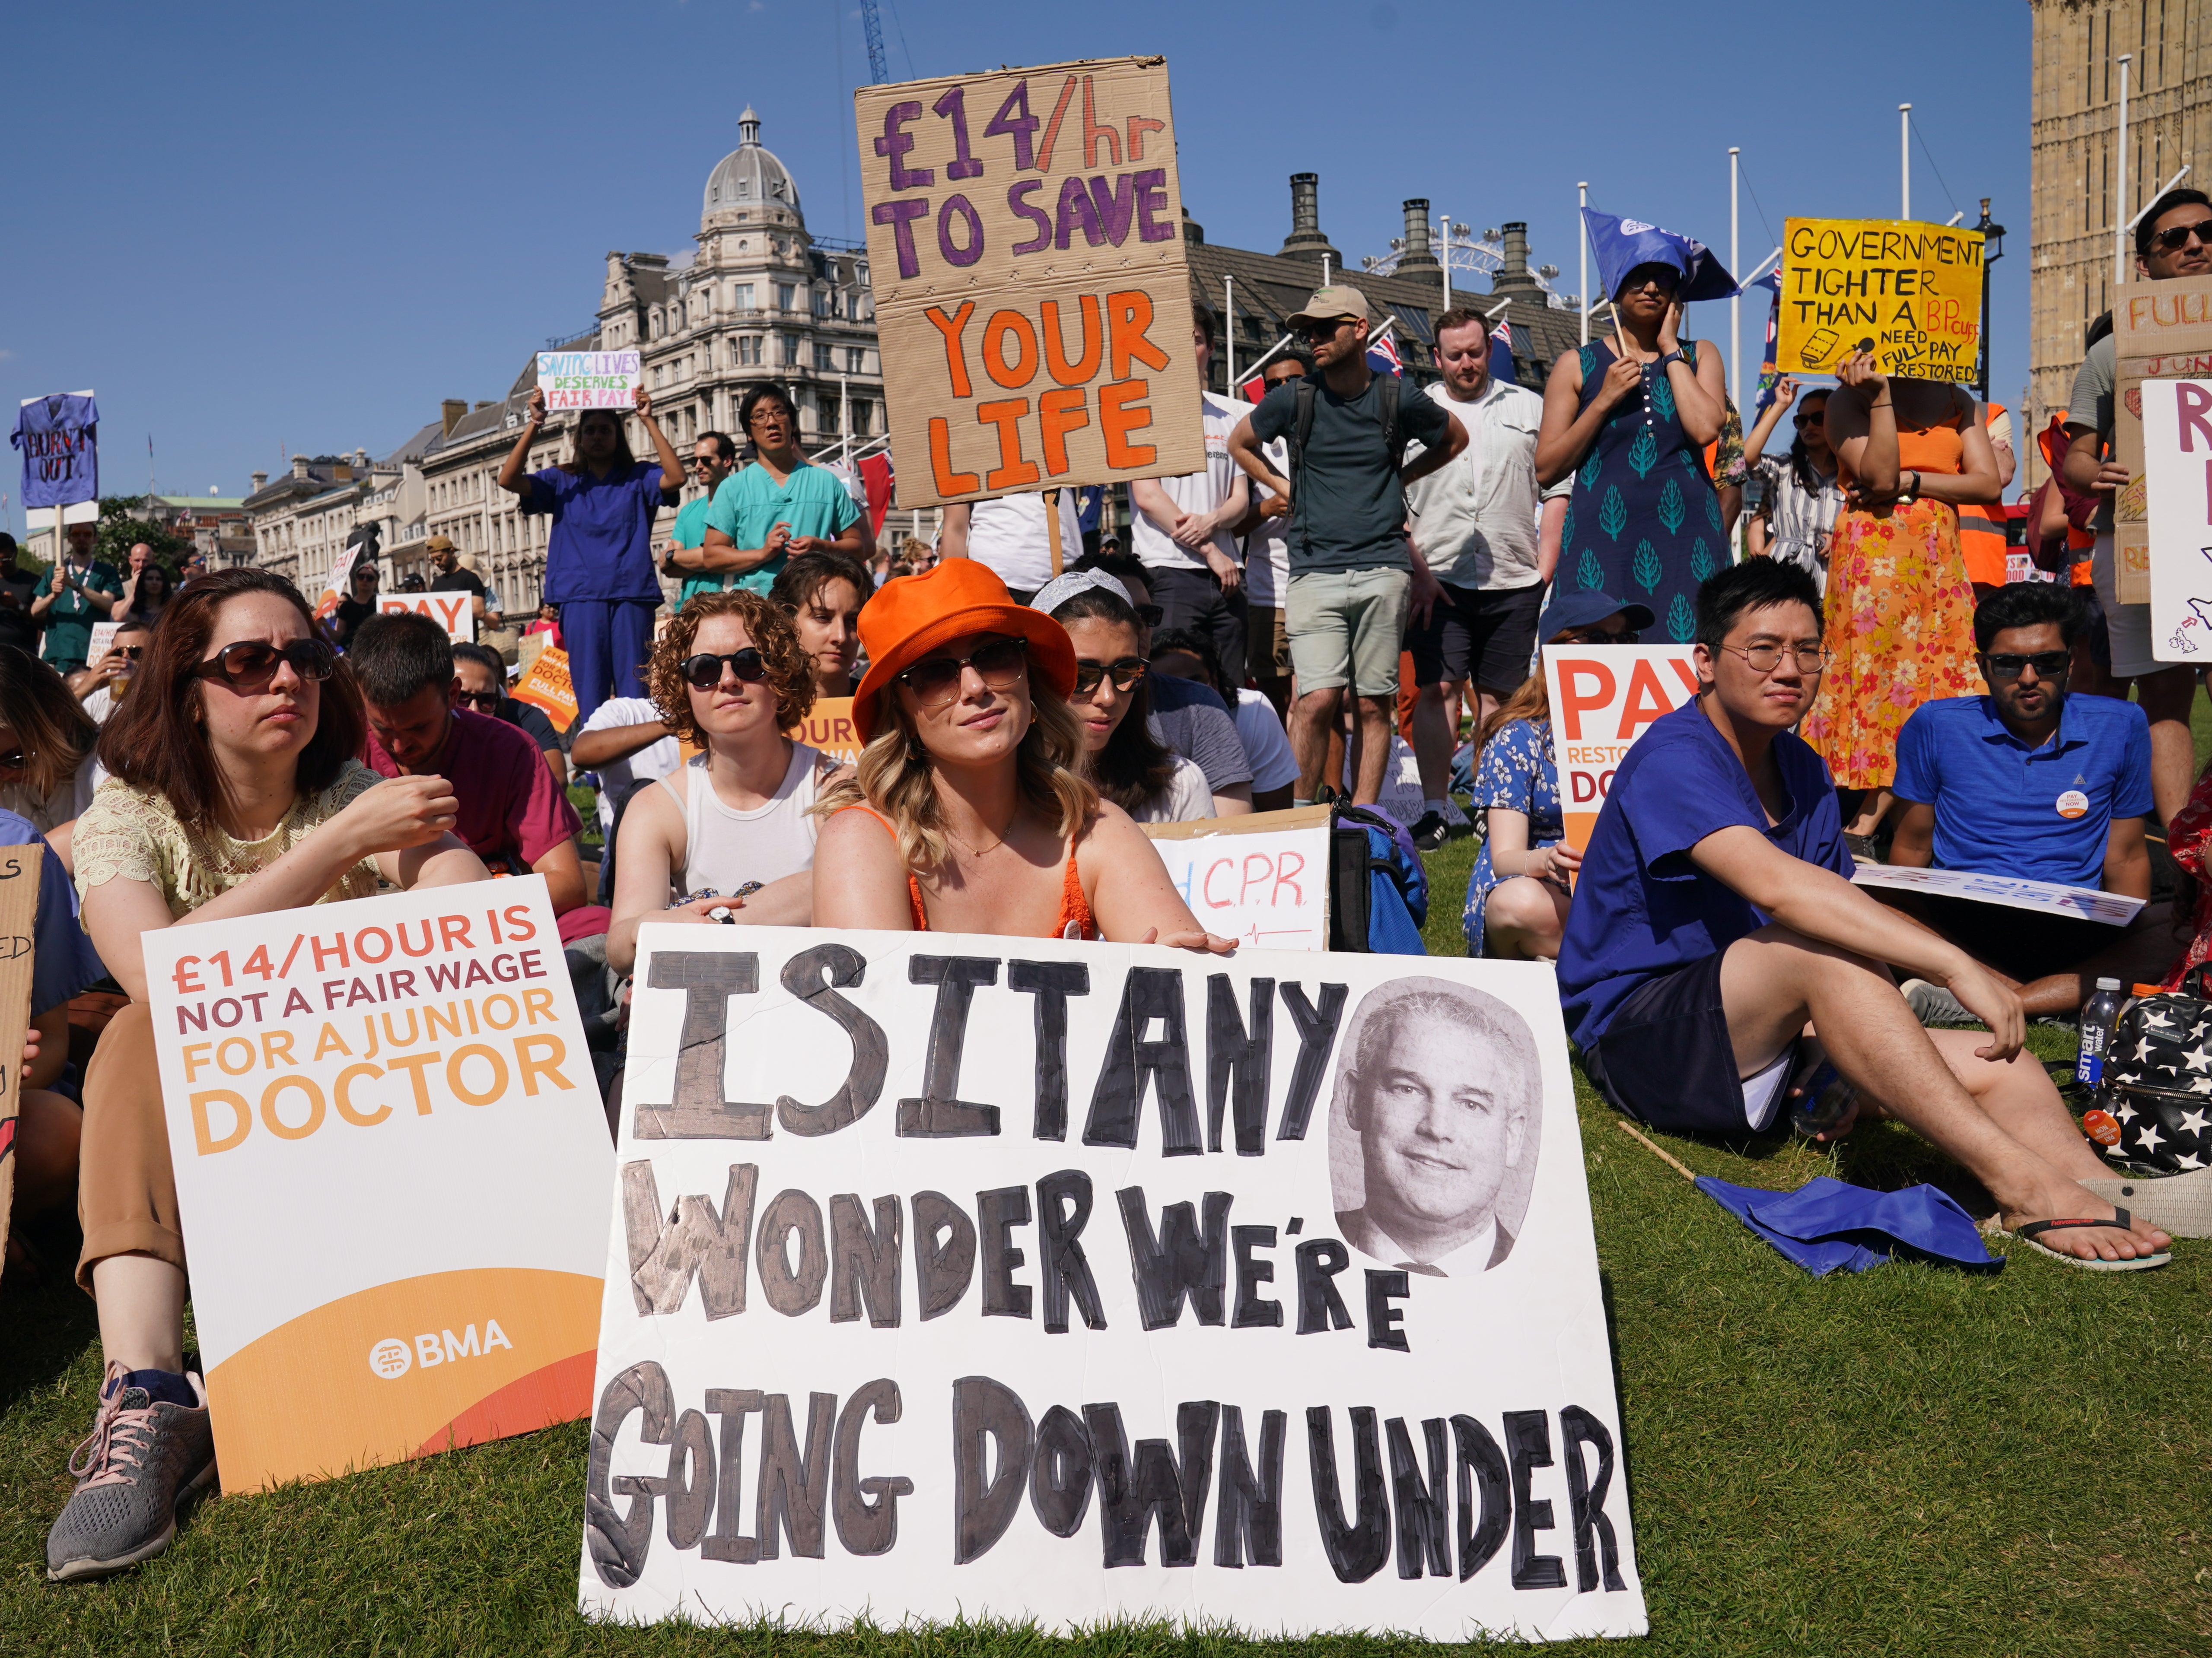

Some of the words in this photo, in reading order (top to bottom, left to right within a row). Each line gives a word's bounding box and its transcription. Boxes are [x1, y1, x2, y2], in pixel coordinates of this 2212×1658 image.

[874, 75, 1165, 191] £14/hr
[872, 194, 984, 279] TO
[1008, 168, 1175, 257] SAVE
[1791, 227, 1985, 267] GOVERNMENT
[1792, 268, 1939, 297] TIGHTER
[1792, 301, 1877, 326] THAN
[1892, 301, 1916, 330] A
[1927, 299, 1960, 332] BP
[923, 289, 1171, 398] YOUR
[1881, 330, 1927, 344] NEED
[1882, 343, 1926, 367] FULL
[1929, 341, 1962, 361] PAY
[595, 353, 638, 374] LIVES
[549, 390, 592, 409] FAIR
[555, 375, 628, 389] DESERVES
[928, 378, 1157, 498] LIFE
[331, 546, 359, 575] PAY
[538, 659, 555, 670] FOR
[542, 654, 557, 664] NOT
[530, 677, 555, 694] FULL
[557, 689, 576, 703] PAY
[172, 914, 476, 994] £14/HOUR
[486, 905, 537, 945] IS
[176, 992, 268, 1035] NOT
[283, 987, 314, 1018] A
[322, 970, 420, 1011] FAIR
[425, 949, 548, 993] WAGE
[181, 1030, 299, 1083] FOR
[313, 1022, 353, 1062] A
[363, 988, 560, 1060] JUNIOR
[632, 943, 889, 1141] IS
[895, 954, 1090, 1141] IT
[1082, 966, 1349, 1157] ANY
[2078, 1024, 2095, 1081] smart
[2094, 1026, 2104, 1052] water
[188, 1033, 577, 1156] DOCTOR
[2095, 1124, 2109, 1135] NOW
[2105, 1134, 2115, 1143] PAY
[623, 1159, 1107, 1334] WONDER
[1115, 1185, 1411, 1353] WE'RE
[414, 1319, 513, 1369] BMA
[586, 1359, 914, 1590] GOING
[952, 1375, 1283, 1568] DOWN
[1305, 1404, 1627, 1593] UNDER
